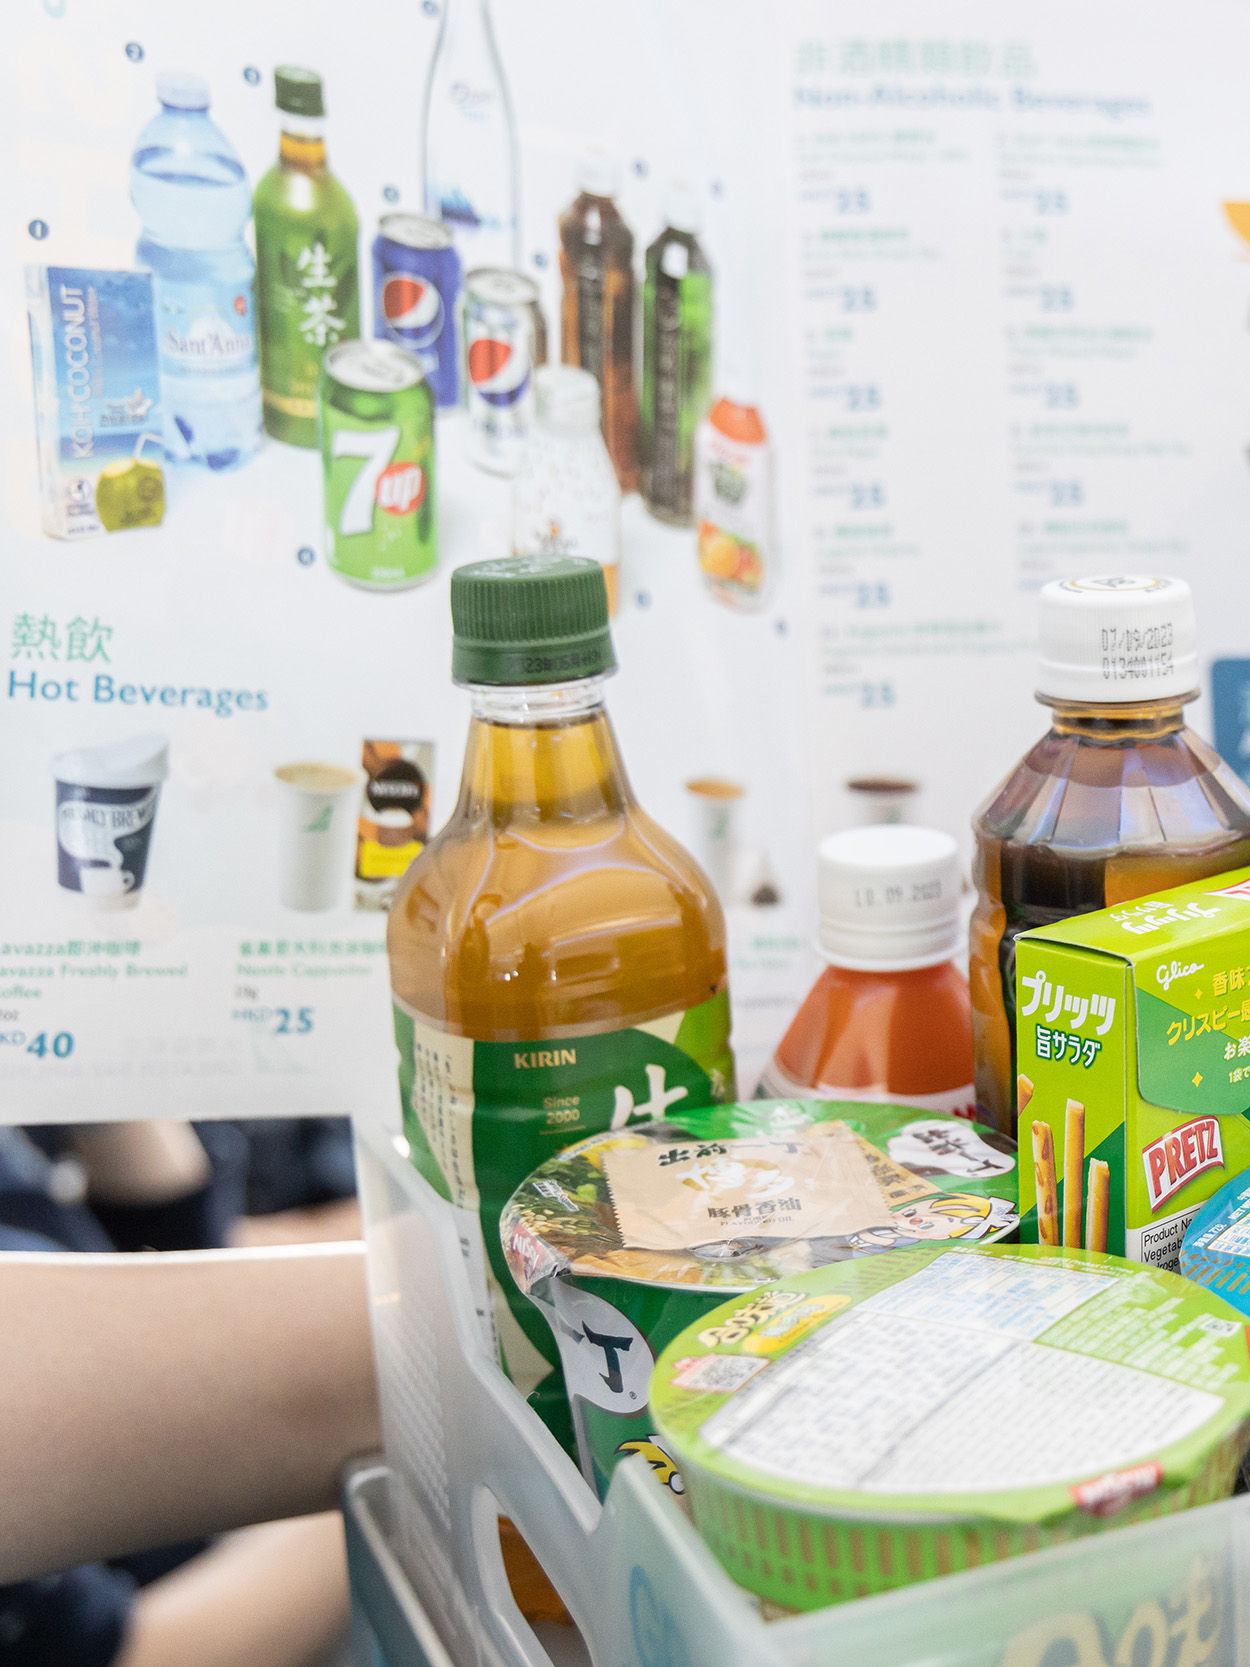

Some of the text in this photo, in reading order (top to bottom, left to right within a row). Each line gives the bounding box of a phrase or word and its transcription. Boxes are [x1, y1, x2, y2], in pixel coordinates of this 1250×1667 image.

[298, 243, 345, 346] 生茶
[60, 284, 92, 401] COCONUT
[333, 427, 401, 538] 7
[11, 613, 113, 662] 熱飲
[1101, 621, 1173, 651] 07/09/2023
[9, 670, 268, 718] Hot Beverages
[0, 964, 54, 978] avazza
[126, 963, 188, 978] Brewed
[1156, 961, 1204, 990] Glico
[0, 985, 43, 998] offee
[1022, 970, 1116, 1036] プリッツ
[275, 1007, 315, 1034] 25
[514, 1049, 577, 1069] KIRIN
[1036, 1025, 1101, 1067] 旨サラダ
[544, 1095, 580, 1109] Since
[545, 1109, 580, 1125] 2000
[1148, 1120, 1218, 1199] PRETZ
[707, 1197, 802, 1219] 豚骨香油
[1143, 1225, 1179, 1247] Product
[1143, 1237, 1183, 1263] Vegetab
